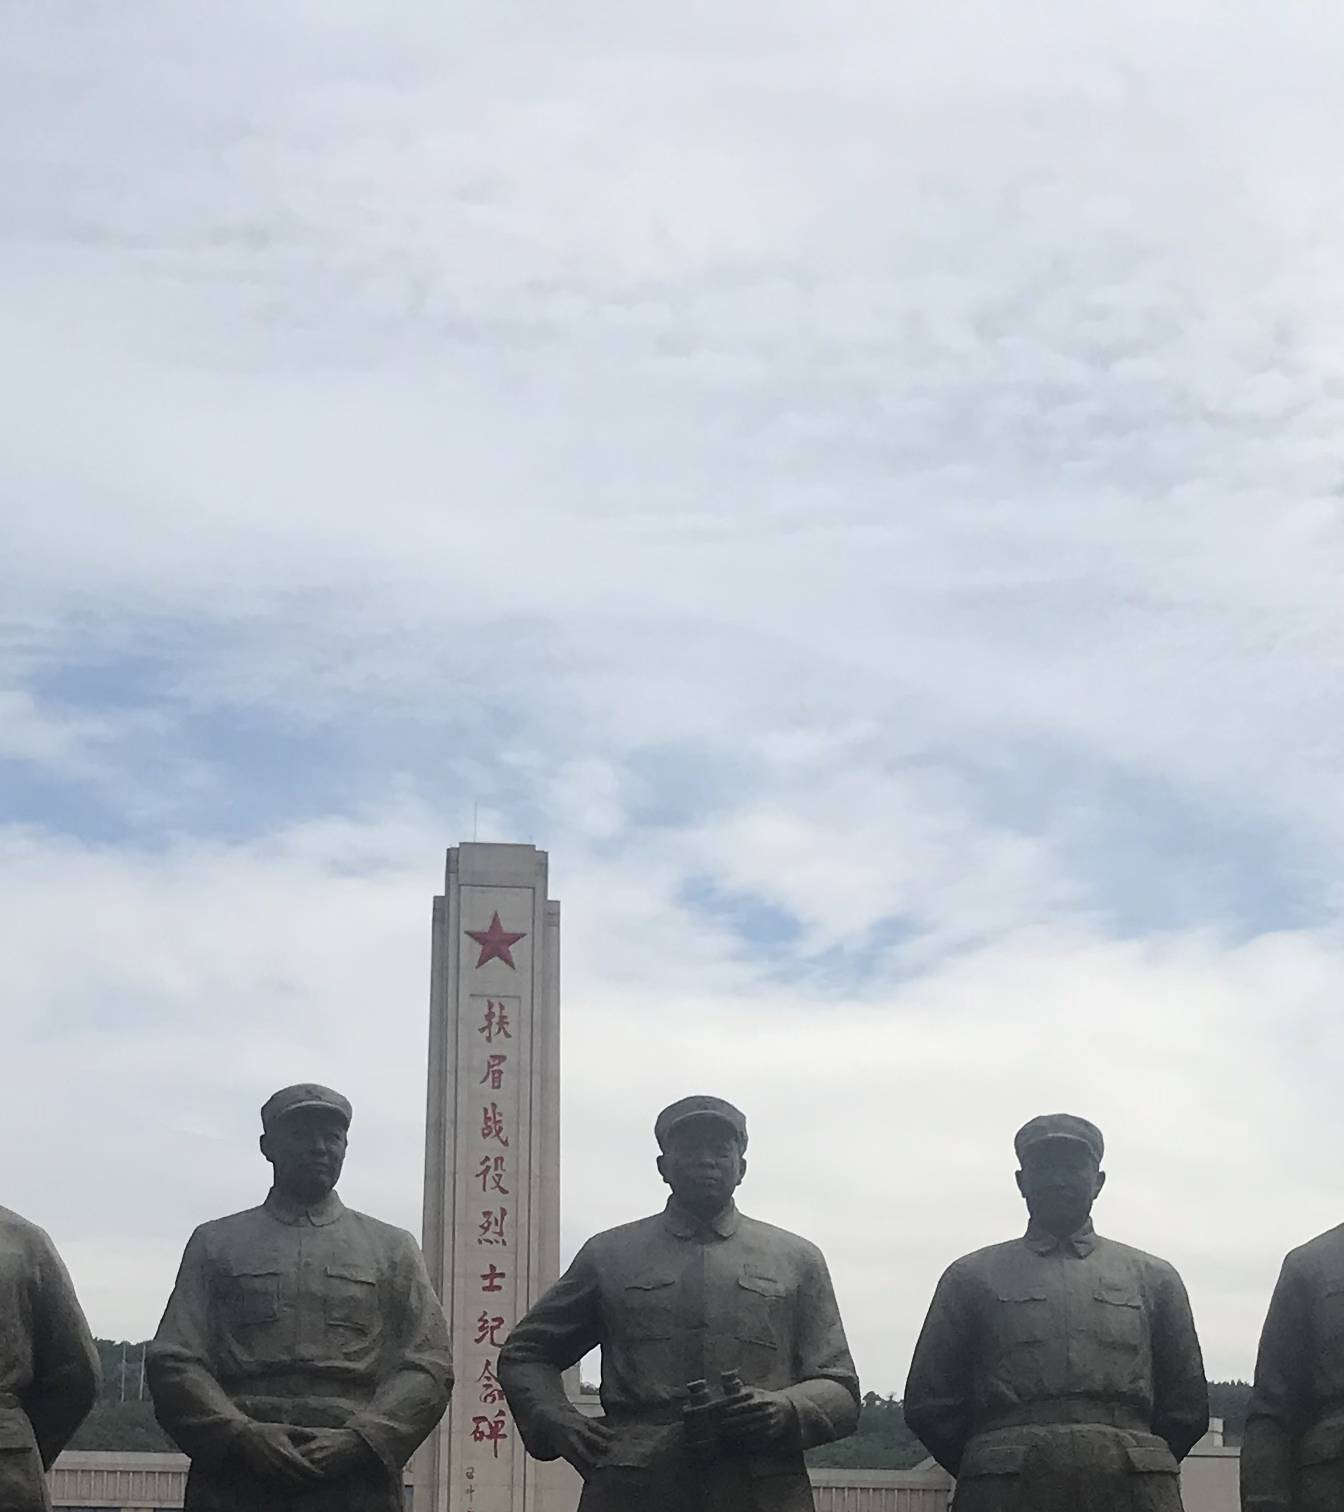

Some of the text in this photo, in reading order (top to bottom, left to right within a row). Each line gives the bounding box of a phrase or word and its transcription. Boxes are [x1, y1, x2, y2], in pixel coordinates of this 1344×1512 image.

[470, 1000, 513, 1459] 扶眉战役烈士纪念碑
